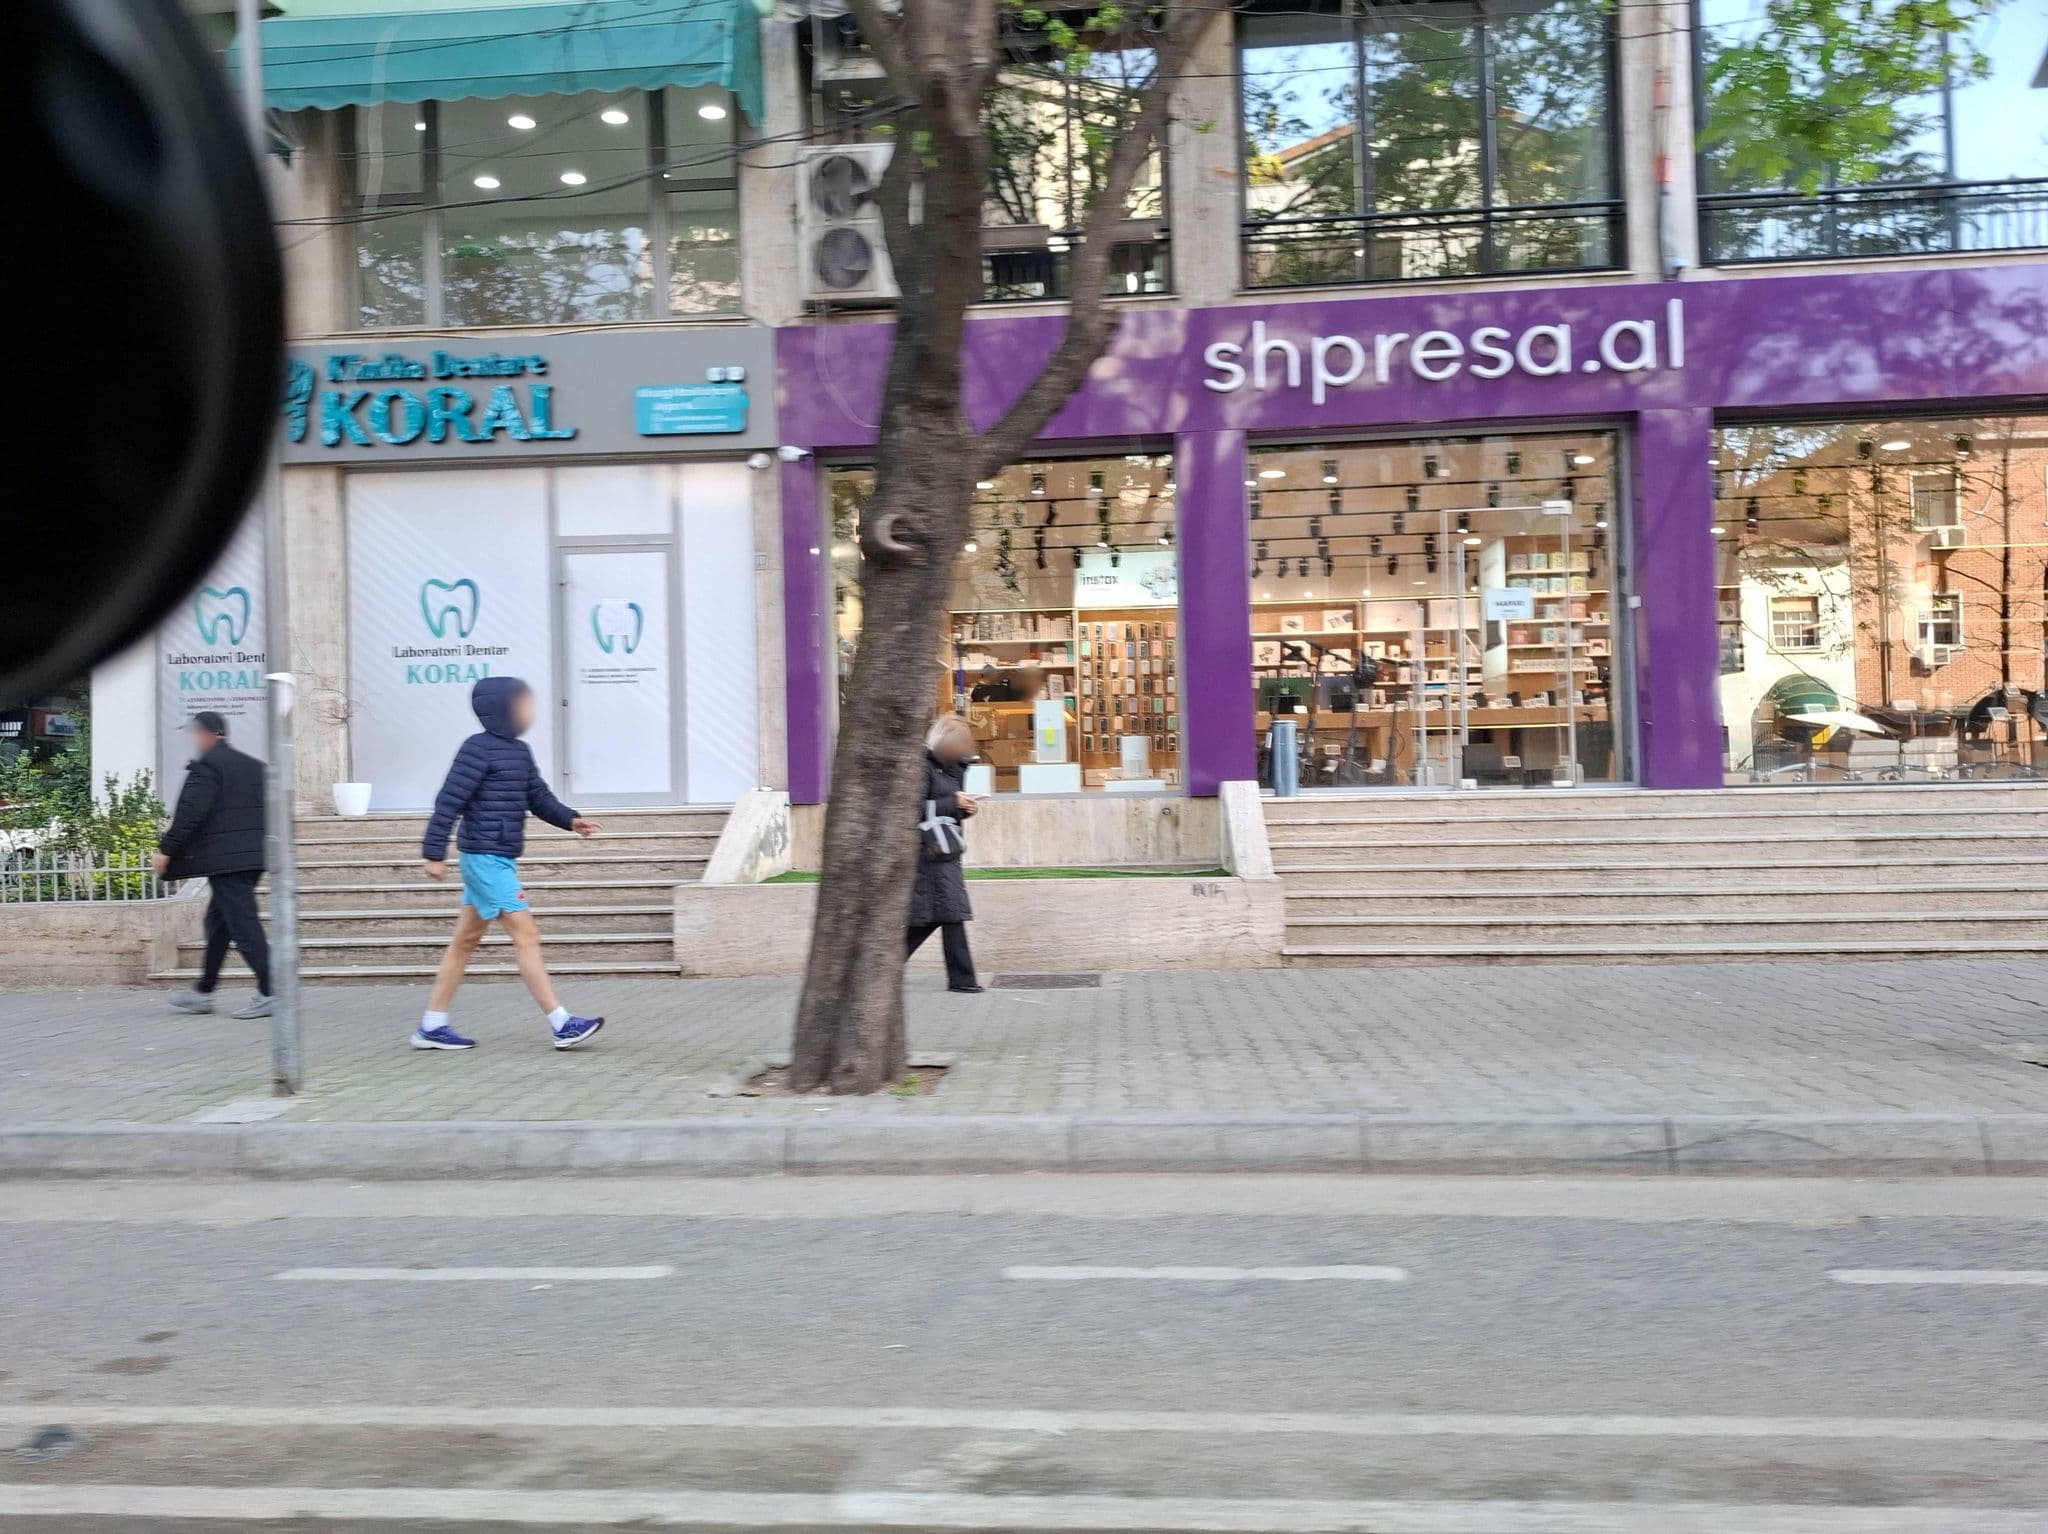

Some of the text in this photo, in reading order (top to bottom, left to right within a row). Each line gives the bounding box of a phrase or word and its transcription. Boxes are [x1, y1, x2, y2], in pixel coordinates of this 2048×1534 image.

[1203, 298, 1686, 405] shpresa.al
[319, 383, 580, 446] KORAL
[167, 651, 266, 665] Laboratori Dent
[392, 643, 510, 658] Laboratori Dentar
[178, 669, 267, 690] KORAL
